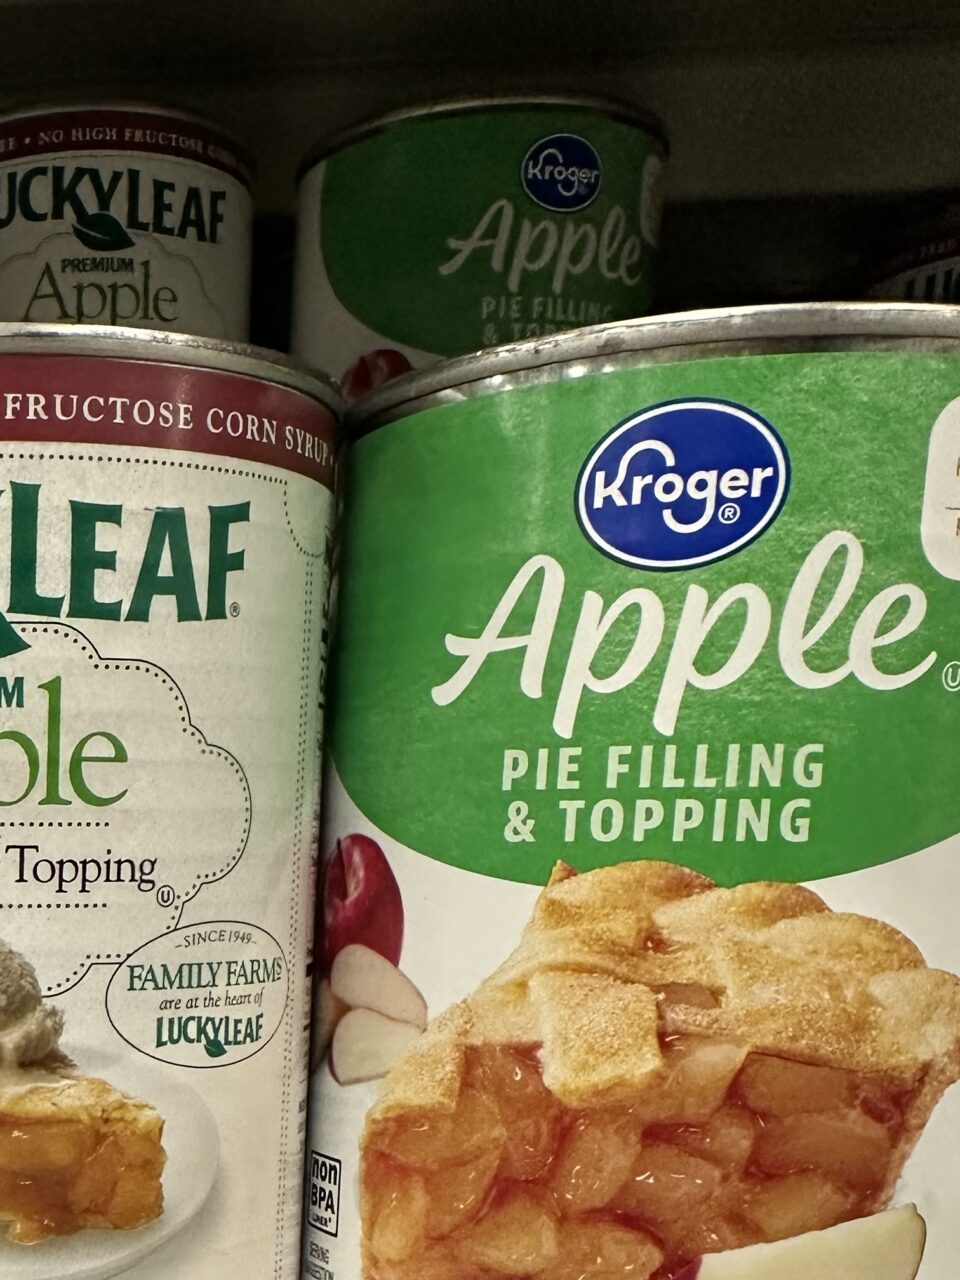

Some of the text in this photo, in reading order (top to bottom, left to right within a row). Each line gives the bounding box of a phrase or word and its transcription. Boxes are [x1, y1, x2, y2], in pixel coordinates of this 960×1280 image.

[39, 129, 64, 146] NO
[528, 148, 599, 196] Kroger
[61, 257, 134, 275] PREMIUM
[439, 199, 642, 294] Apple
[23, 259, 179, 325] Apple
[480, 295, 523, 319] PIE
[3, 393, 193, 429] FRUCTOSE
[207, 408, 278, 445] CORN
[593, 439, 774, 534] Kroger
[431, 530, 938, 740] Apple
[501, 744, 825, 791] PIE FILLING
[503, 798, 812, 843] & TOPPING
[5, 844, 157, 893] Topping
[126, 956, 282, 991] FAMILY FARMS
[159, 990, 252, 1011] are at the heart
[311, 1157, 338, 1186] non
[311, 1184, 335, 1215] BPA
